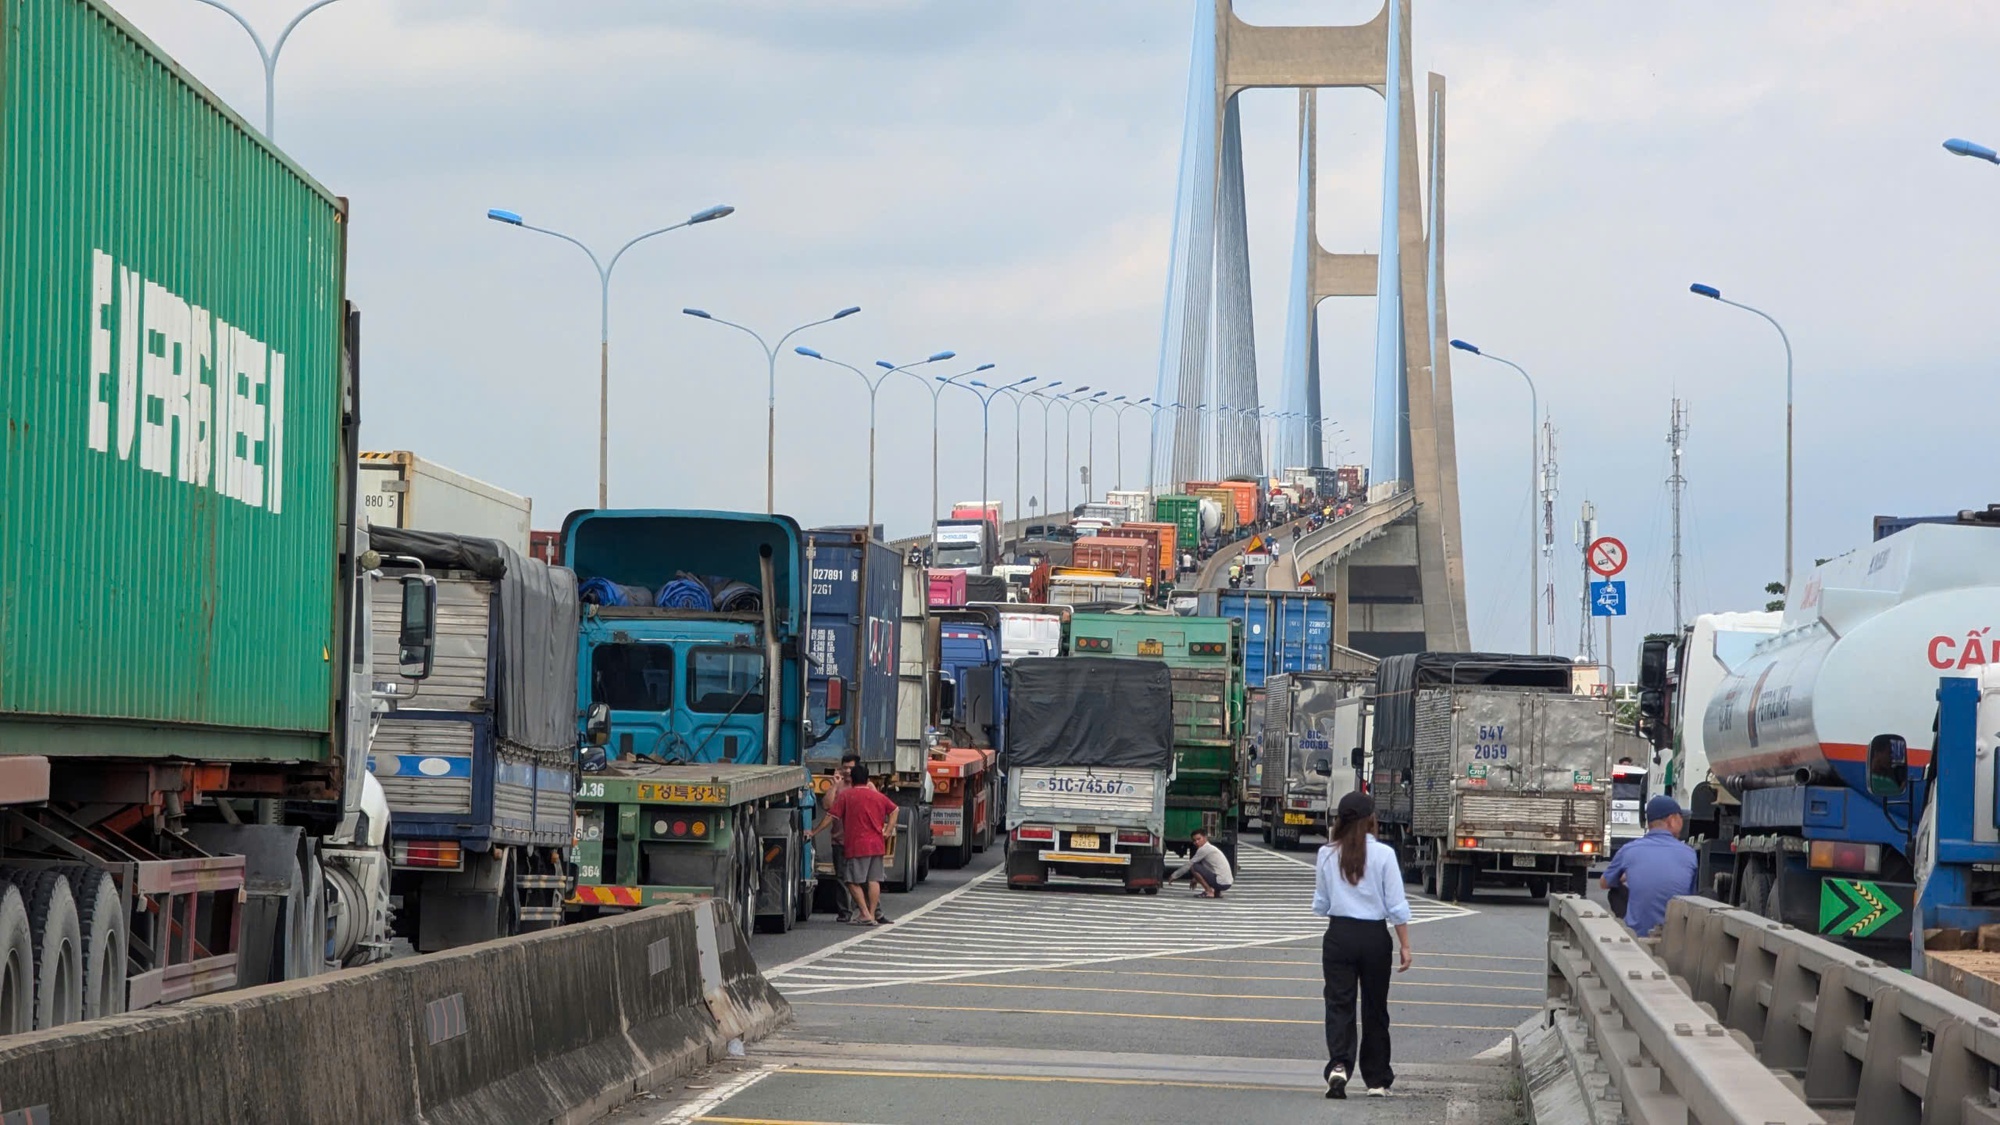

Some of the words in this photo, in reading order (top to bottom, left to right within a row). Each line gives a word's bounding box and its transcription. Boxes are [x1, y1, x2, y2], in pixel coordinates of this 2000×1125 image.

[89, 248, 285, 514] EVERGREEN
[813, 568, 843, 581] 027891
[851, 569, 859, 582] 8
[812, 584, 832, 595] 22G1
[1480, 726, 1504, 741] 54Y
[1474, 745, 1507, 760] 2059
[577, 782, 605, 798] 0.36
[1048, 778, 1124, 794] 51C-745.67
